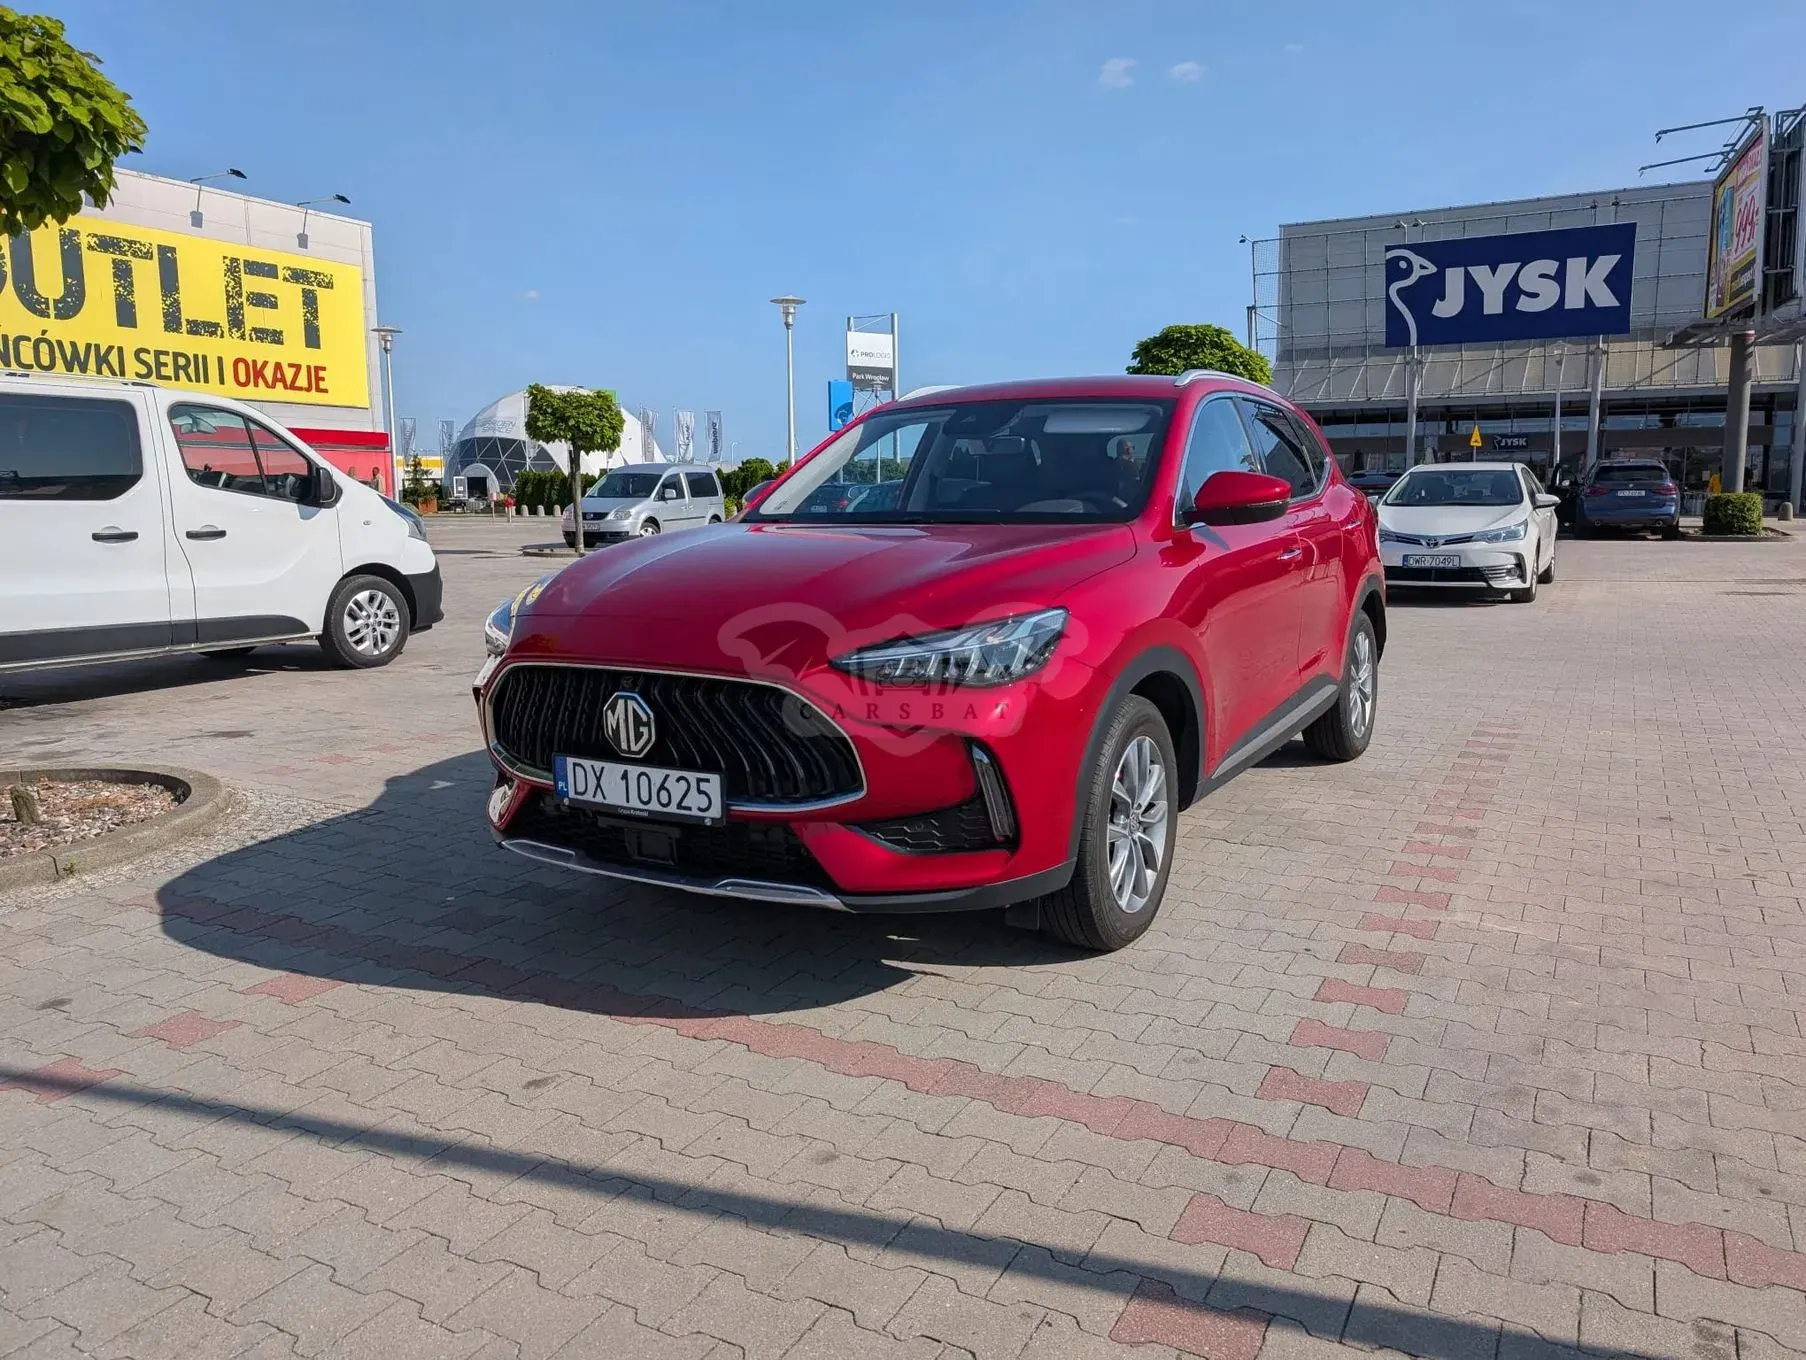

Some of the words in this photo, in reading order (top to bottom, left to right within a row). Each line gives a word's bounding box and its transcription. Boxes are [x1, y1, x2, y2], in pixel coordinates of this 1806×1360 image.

[0, 222, 334, 349] UTLET
[1431, 254, 1622, 318] JYSK
[134, 347, 209, 384] SERII
[217, 356, 225, 385] I
[233, 357, 329, 393] OKAZJE
[1500, 437, 1527, 446] JYSK
[1429, 556, 1458, 567] 7049L
[607, 699, 649, 751] MG
[558, 781, 568, 792] PL
[572, 762, 607, 800] DX
[620, 769, 713, 813] 10625
